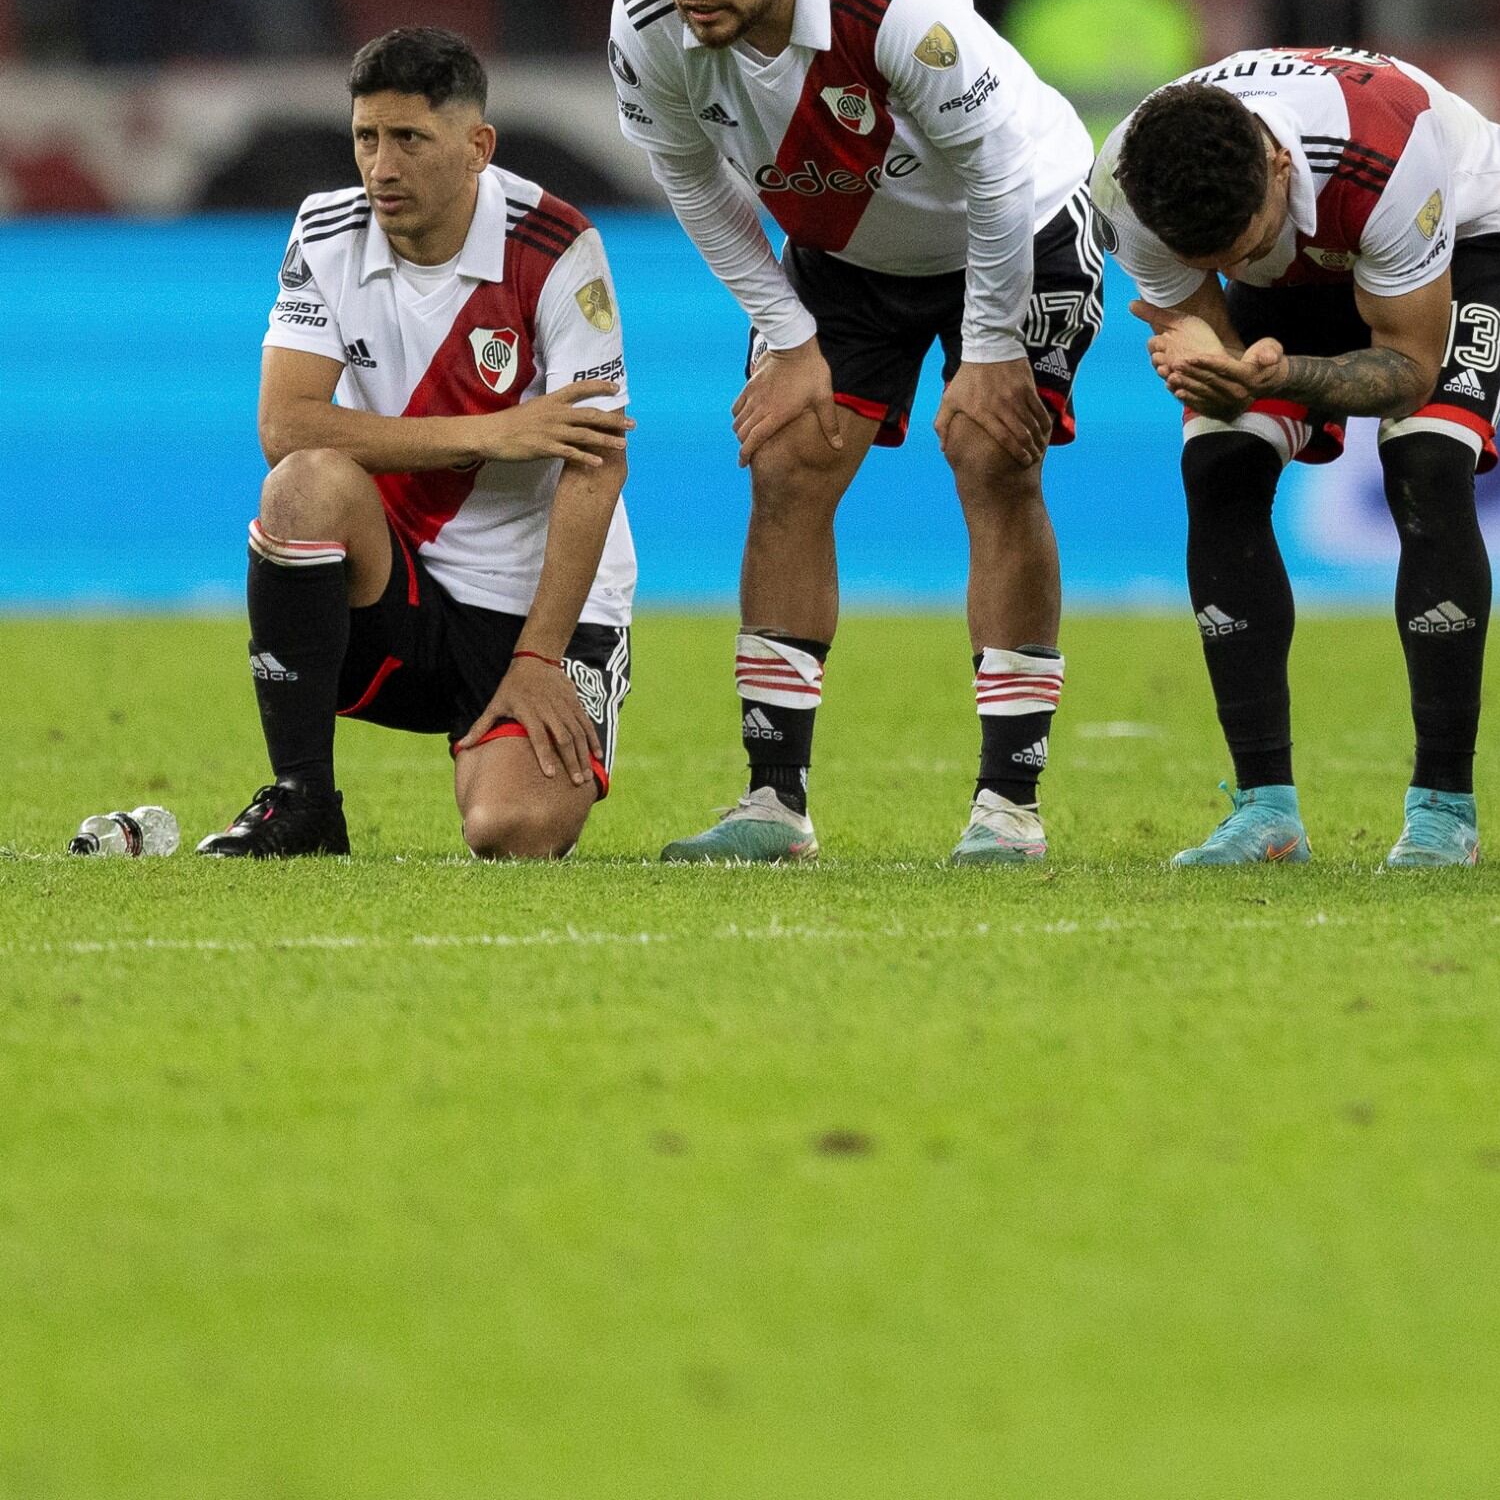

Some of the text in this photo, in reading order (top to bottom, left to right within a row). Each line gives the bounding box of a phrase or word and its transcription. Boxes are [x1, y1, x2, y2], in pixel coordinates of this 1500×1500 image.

[937, 66, 991, 114] ASSIST
[1023, 290, 1085, 350] 17
[481, 340, 512, 371] CARP
[573, 354, 623, 382] ASSIS
[1033, 361, 1072, 381] adidas
[1443, 382, 1485, 401] adidas
[1408, 617, 1477, 634] adidas
[1012, 750, 1048, 768] adid
